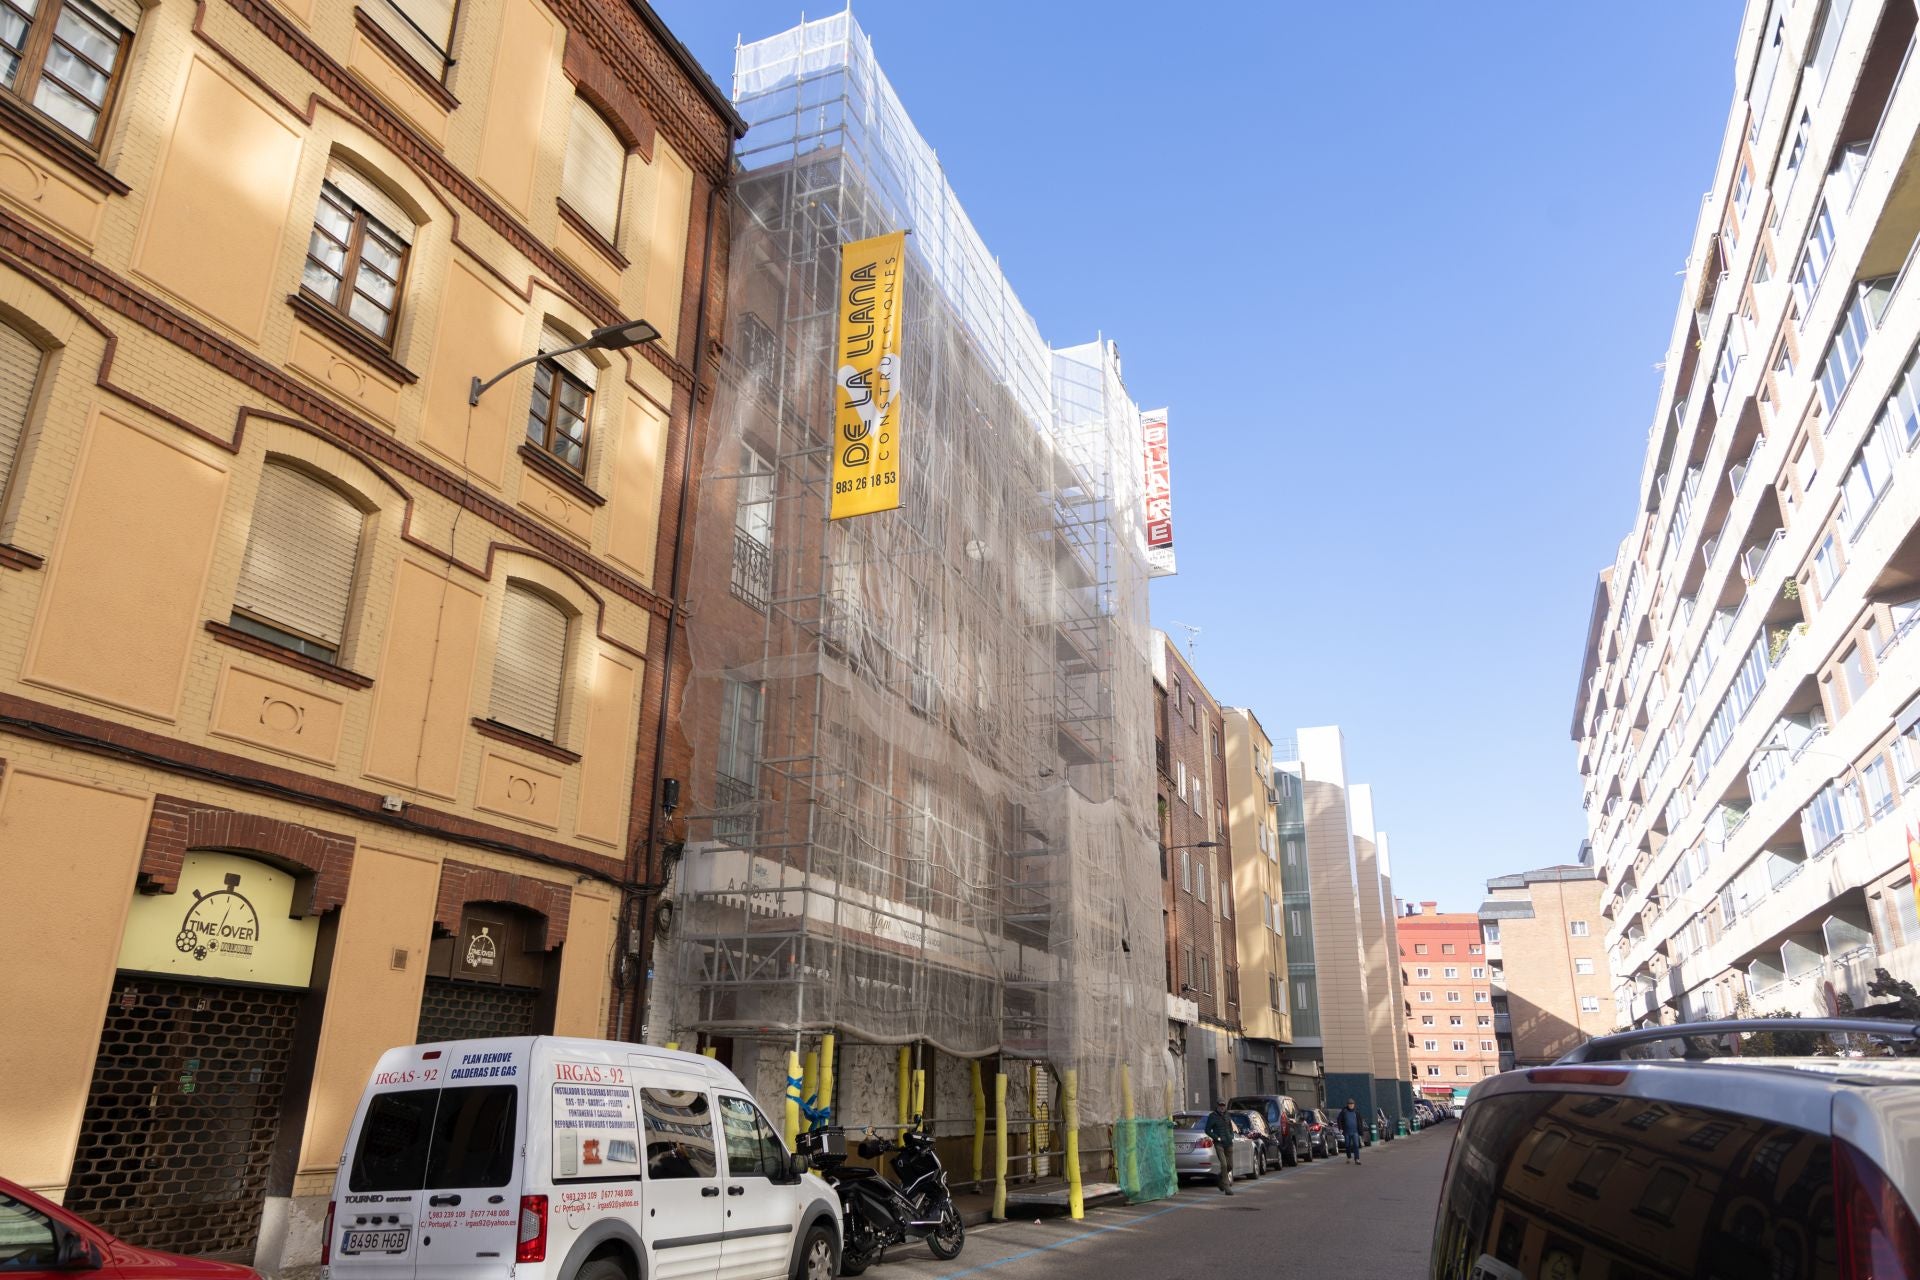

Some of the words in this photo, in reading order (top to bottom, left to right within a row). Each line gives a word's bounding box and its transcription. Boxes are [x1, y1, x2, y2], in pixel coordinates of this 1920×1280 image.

[846, 262, 877, 359] LLANA
[845, 368, 873, 409] LA
[843, 419, 871, 467] DE
[836, 481, 853, 494] 983
[856, 477, 867, 490] 26
[870, 474, 882, 487] 18
[884, 471, 896, 485] 53
[190, 920, 217, 936] TIME
[221, 925, 254, 940] OVER
[462, 1053, 482, 1065] PLAN
[482, 1052, 512, 1063] RENOVE
[375, 1070, 415, 1085] IRGAS
[423, 1069, 438, 1081] 92
[451, 1067, 489, 1079] CALDERAS
[489, 1066, 499, 1077] DE
[501, 1065, 517, 1076] GAS
[555, 1064, 601, 1082] IRGAS
[610, 1068, 624, 1083] 92
[345, 1195, 384, 1203] TOURNEO
[432, 1211, 443, 1219] 983
[444, 1211, 454, 1219] 239
[350, 1232, 379, 1249] 8496
[381, 1232, 405, 1248] HGB
